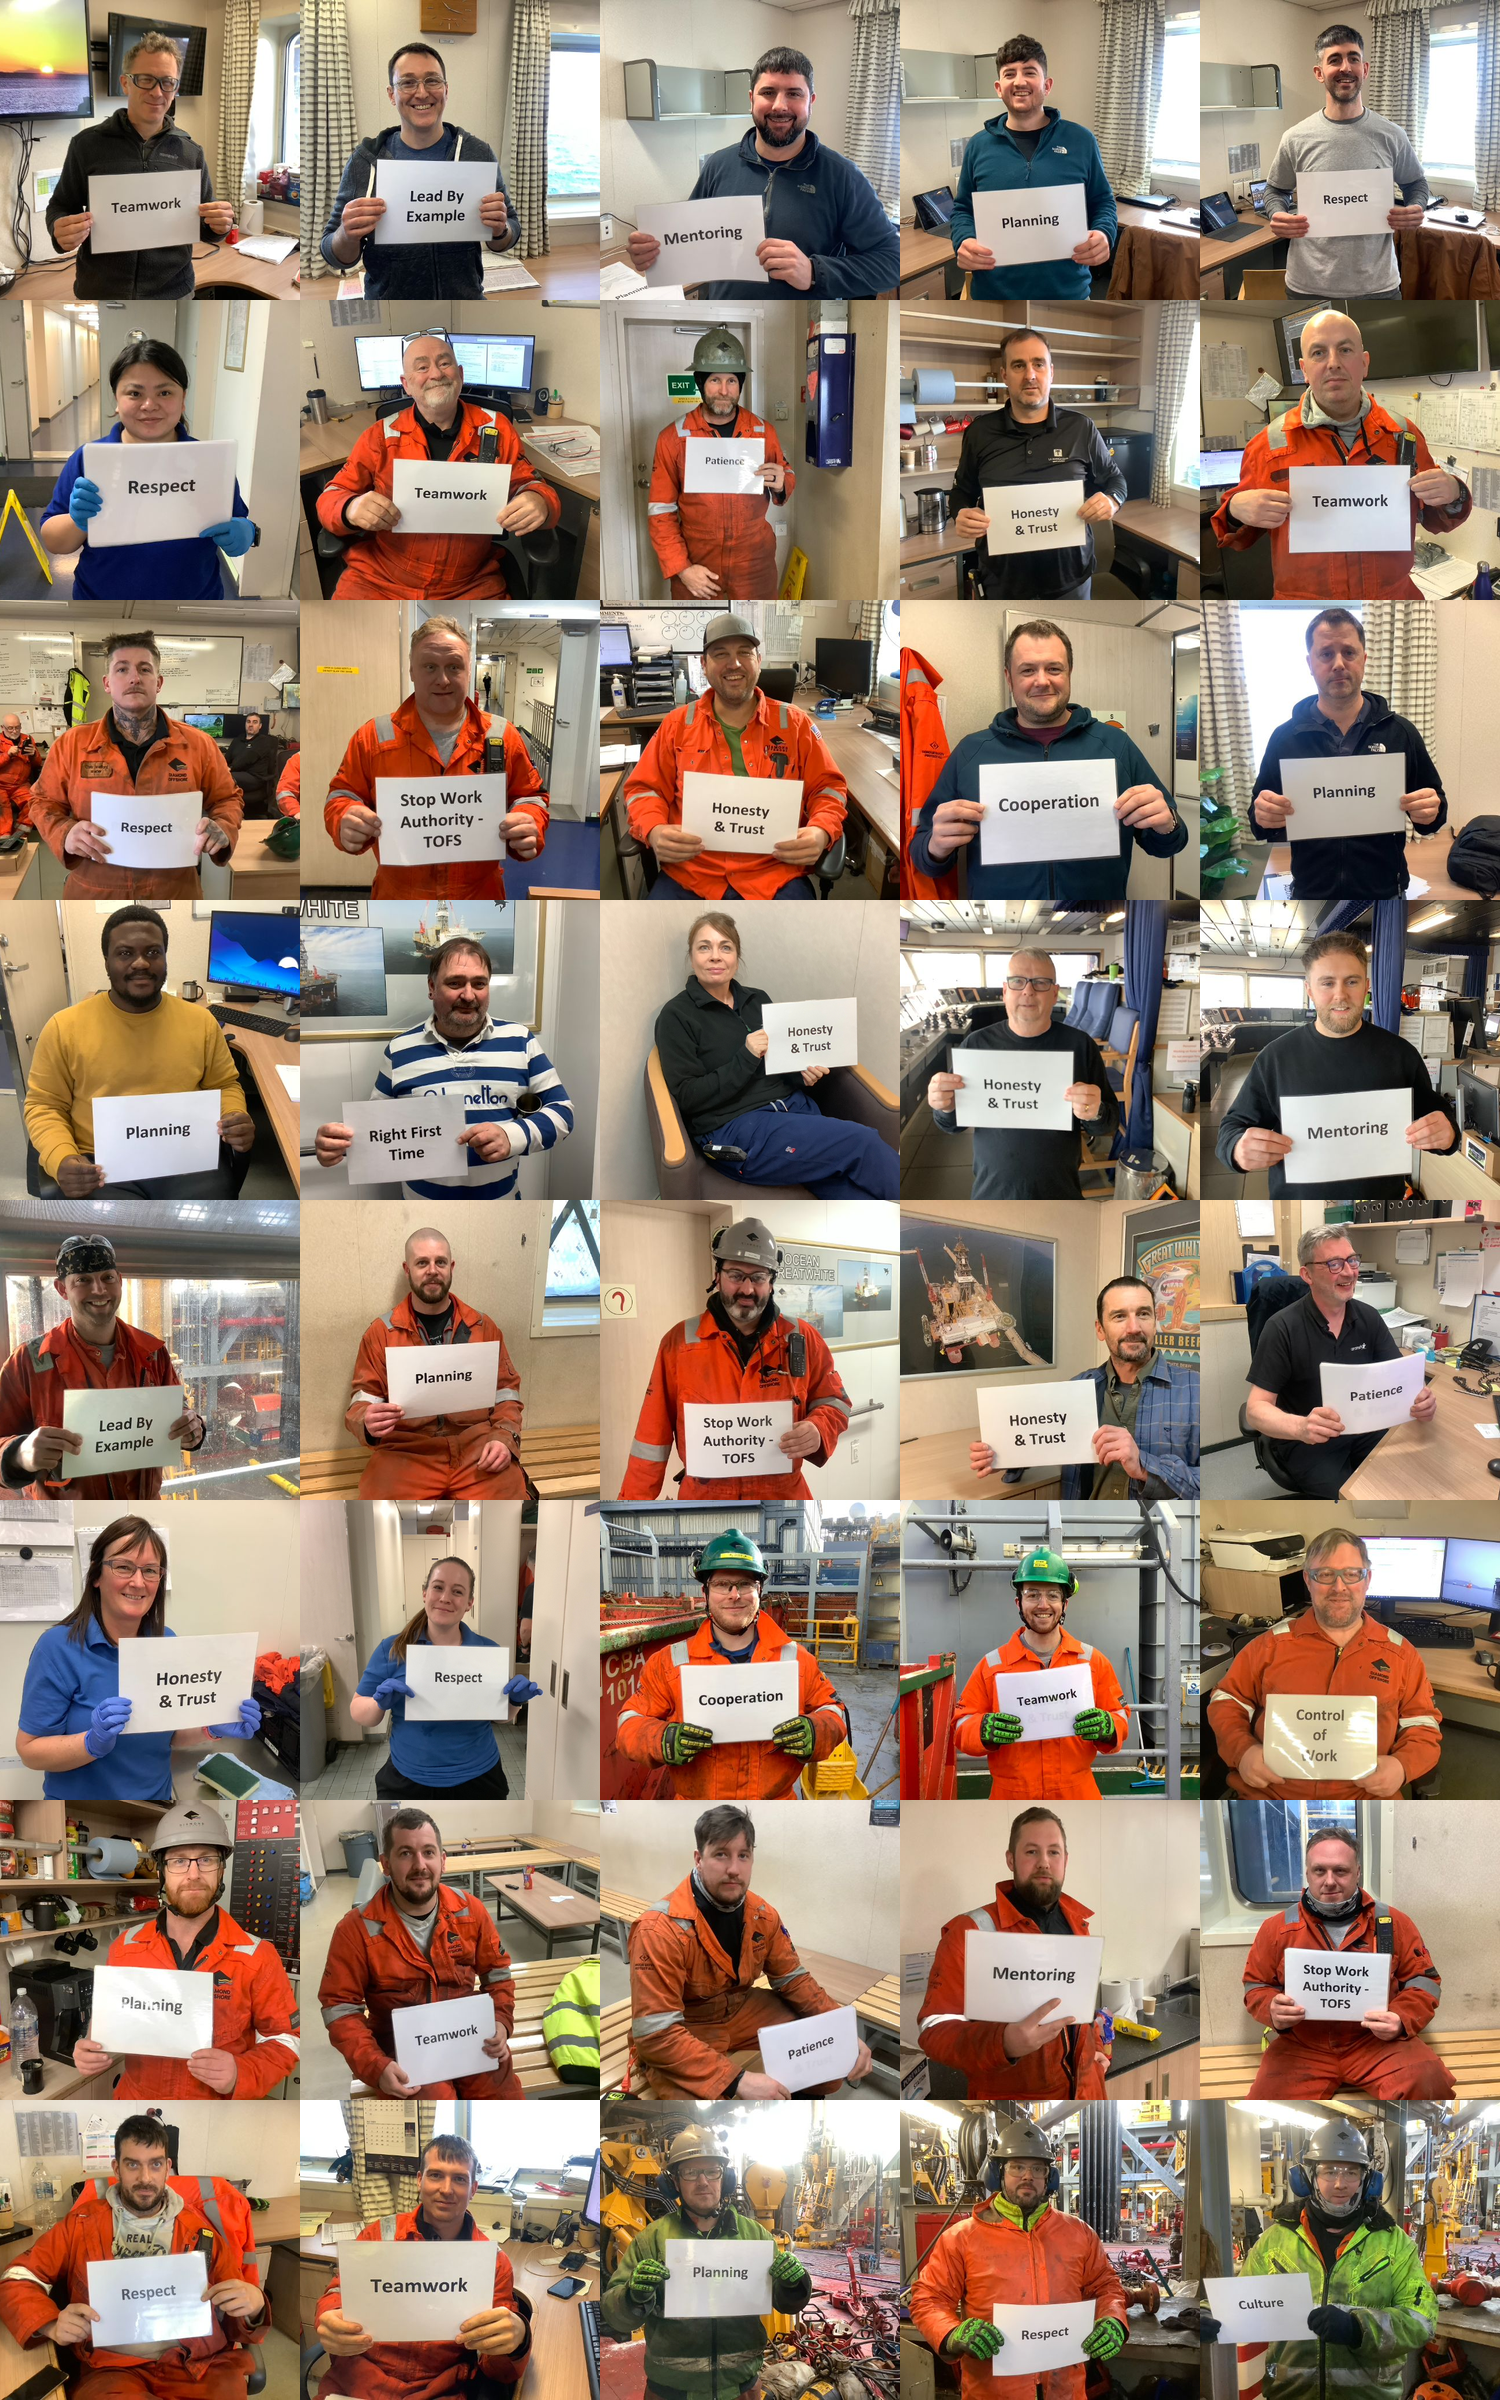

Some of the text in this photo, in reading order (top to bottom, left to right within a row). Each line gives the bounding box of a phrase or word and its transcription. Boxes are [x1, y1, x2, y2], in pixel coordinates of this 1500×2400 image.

[410, 189, 465, 205] Lead By
[1323, 193, 1369, 206] Respect
[110, 197, 181, 214] Teamwork
[406, 209, 466, 224] Example
[1001, 214, 1060, 229] Planning
[663, 226, 743, 246] Mentoring
[614, 285, 649, 300] Planning
[671, 381, 690, 389] EXIT
[705, 456, 744, 465] Patience
[128, 479, 196, 497] Respect
[414, 487, 488, 501] Teamwork
[1311, 493, 1389, 508] Teamwork
[1011, 507, 1060, 520] Honesty
[1015, 522, 1058, 536] & Trust
[400, 789, 483, 809] Stop Work
[1313, 784, 1376, 799] Planning
[712, 802, 770, 820] Honesty
[998, 793, 1100, 814] Cooperation
[400, 812, 474, 829] Authority
[714, 821, 765, 835] & Trust
[121, 822, 173, 836] Respect
[423, 834, 462, 849] TOFS
[787, 1024, 833, 1038] Honesty
[790, 1041, 832, 1054] & Trust
[983, 1078, 1042, 1094] Honesty
[987, 1097, 1039, 1110] & Trust
[126, 1123, 191, 1140] Planning
[369, 1125, 442, 1144] Right First
[1307, 1121, 1389, 1140] Mentoring
[388, 1148, 425, 1161] Time
[784, 1252, 820, 1268] OCEAN
[1141, 1242, 1174, 1273] GREAT
[777, 1267, 836, 1282] REATWHITE
[1154, 1335, 1175, 1346] LLER
[415, 1370, 473, 1385] Planning
[1350, 1385, 1403, 1402] Patience
[99, 1416, 153, 1432] Lead By
[703, 1415, 773, 1431] Stop Work
[1009, 1412, 1067, 1427] Honesty
[95, 1435, 154, 1454] Example
[703, 1434, 766, 1448] Authority
[1014, 1432, 1066, 1447] & Trust
[722, 1452, 755, 1464] TOFS
[605, 1651, 646, 1678] CBA
[156, 1669, 222, 1686] Honesty
[434, 1671, 483, 1685] Respect
[1368, 1675, 1389, 1685] OFFSHORE
[1370, 1671, 1389, 1680] DIAMOND
[159, 1691, 217, 1709] & Trust
[698, 1690, 783, 1708] Cooperation
[1016, 1688, 1078, 1707] Teamwork
[1296, 1709, 1345, 1722] Control
[1312, 1728, 1328, 1741] of
[1301, 1748, 1338, 1762] Work
[992, 1966, 1076, 1984] Mentoring
[1303, 1964, 1369, 1978] Stop Work
[1302, 1981, 1362, 1996] Authority
[121, 1996, 183, 2016] Planning
[1319, 1998, 1351, 2009] TOFS
[414, 2024, 479, 2046] Teamwork
[788, 2036, 834, 2060] Patience
[902, 2059, 927, 2089] PORTWEST
[126, 2233, 153, 2244] REAL
[693, 2266, 749, 2281] Planning
[121, 2284, 177, 2301] Respect
[369, 2277, 468, 2294] Teamwork
[1238, 2298, 1284, 2310] Culture
[1021, 2327, 1070, 2341] Respect
